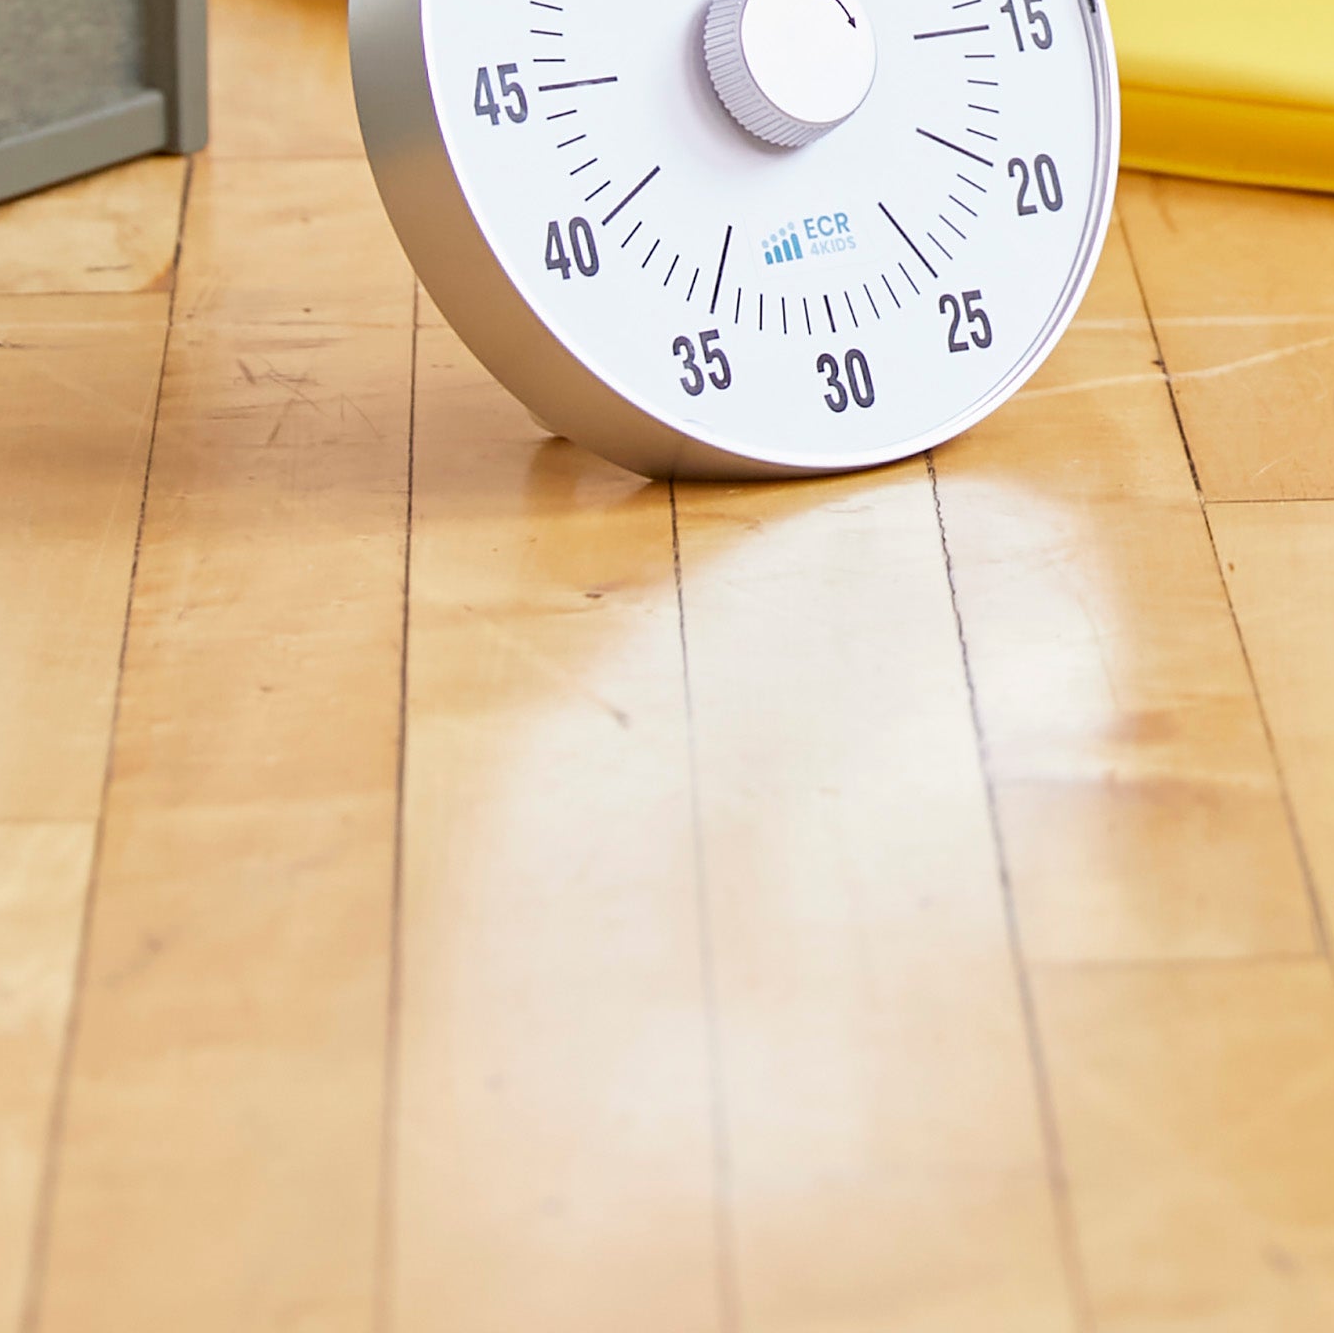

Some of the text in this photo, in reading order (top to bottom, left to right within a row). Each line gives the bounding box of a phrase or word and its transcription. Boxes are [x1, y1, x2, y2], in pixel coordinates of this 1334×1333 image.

[473, 63, 529, 125] 45
[1007, 152, 1063, 217] 20
[544, 216, 600, 280] 40
[803, 213, 850, 239] ECR
[810, 236, 856, 255] 4KIDS
[939, 289, 992, 353] 25
[672, 329, 732, 397] 35
[816, 352, 875, 412] 30
